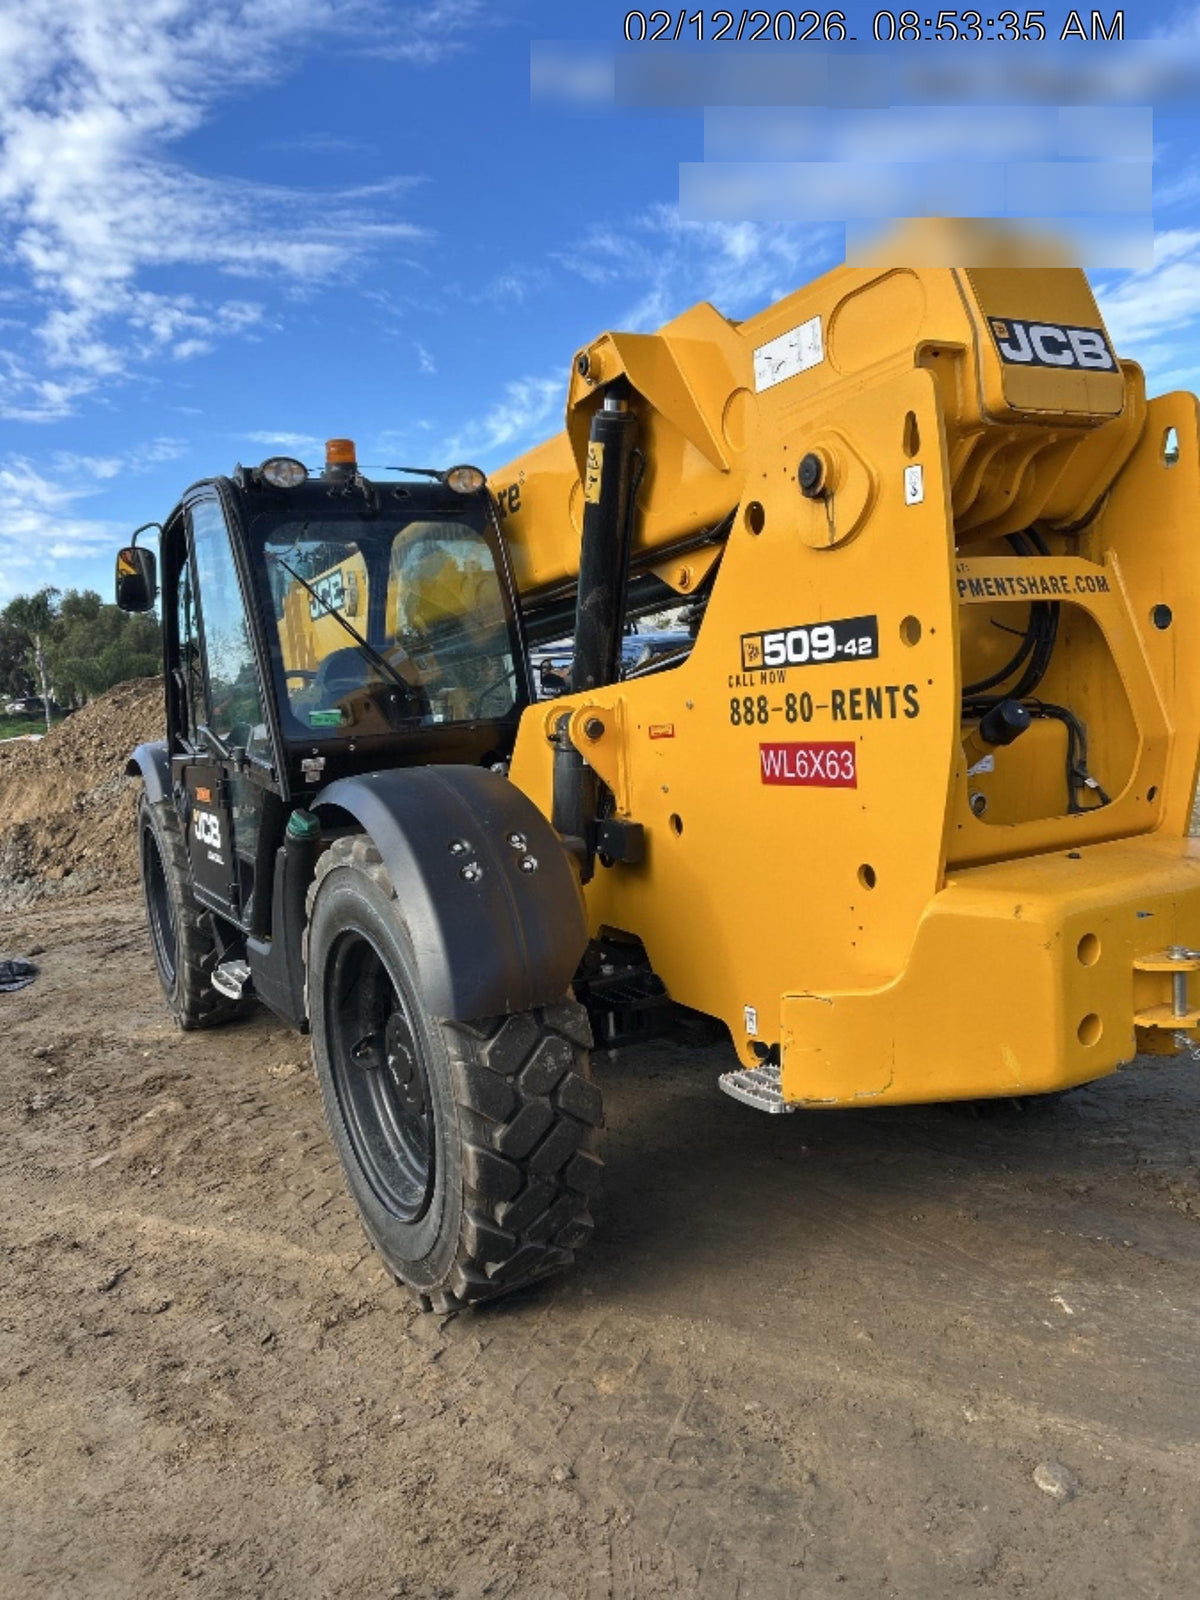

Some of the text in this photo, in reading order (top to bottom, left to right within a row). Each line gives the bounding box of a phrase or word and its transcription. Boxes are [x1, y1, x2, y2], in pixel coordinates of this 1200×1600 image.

[999, 323, 1113, 369] JCB
[956, 575, 1110, 598] PMENTSHARE.COM
[728, 670, 786, 688] CALL NOW
[730, 684, 920, 726] 888-80-RENTS
[760, 749, 854, 779] WL6X63
[194, 811, 221, 848] JCB
